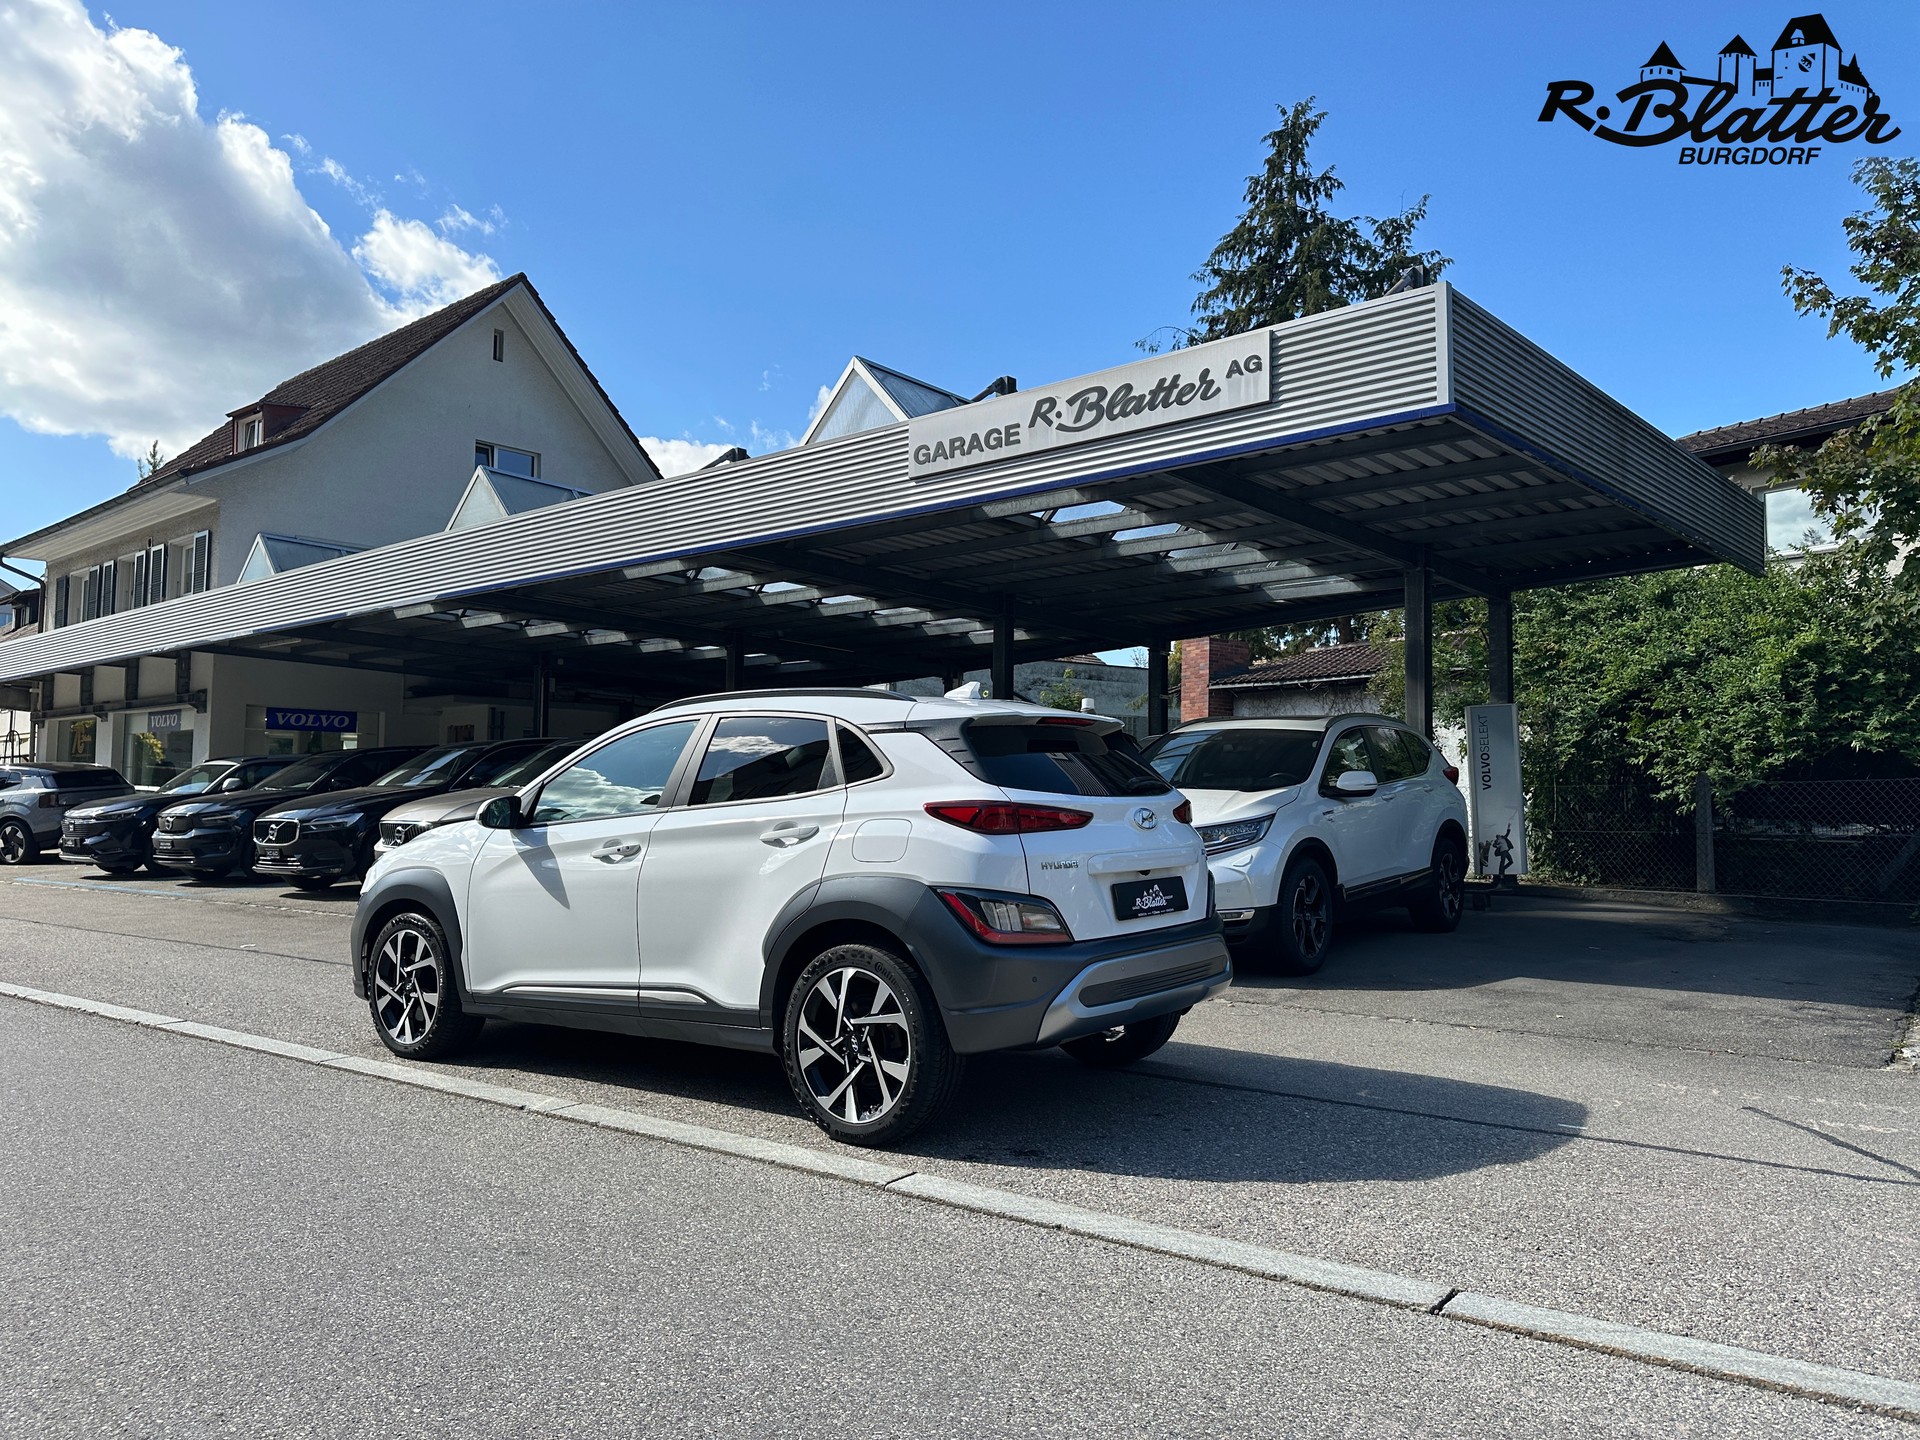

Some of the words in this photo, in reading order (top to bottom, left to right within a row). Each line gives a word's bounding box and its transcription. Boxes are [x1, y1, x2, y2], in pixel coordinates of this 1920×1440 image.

[913, 423, 1021, 465] GARAGE
[1225, 354, 1263, 379] AG
[151, 713, 178, 728] VOLVO
[275, 712, 350, 729] VOLVO
